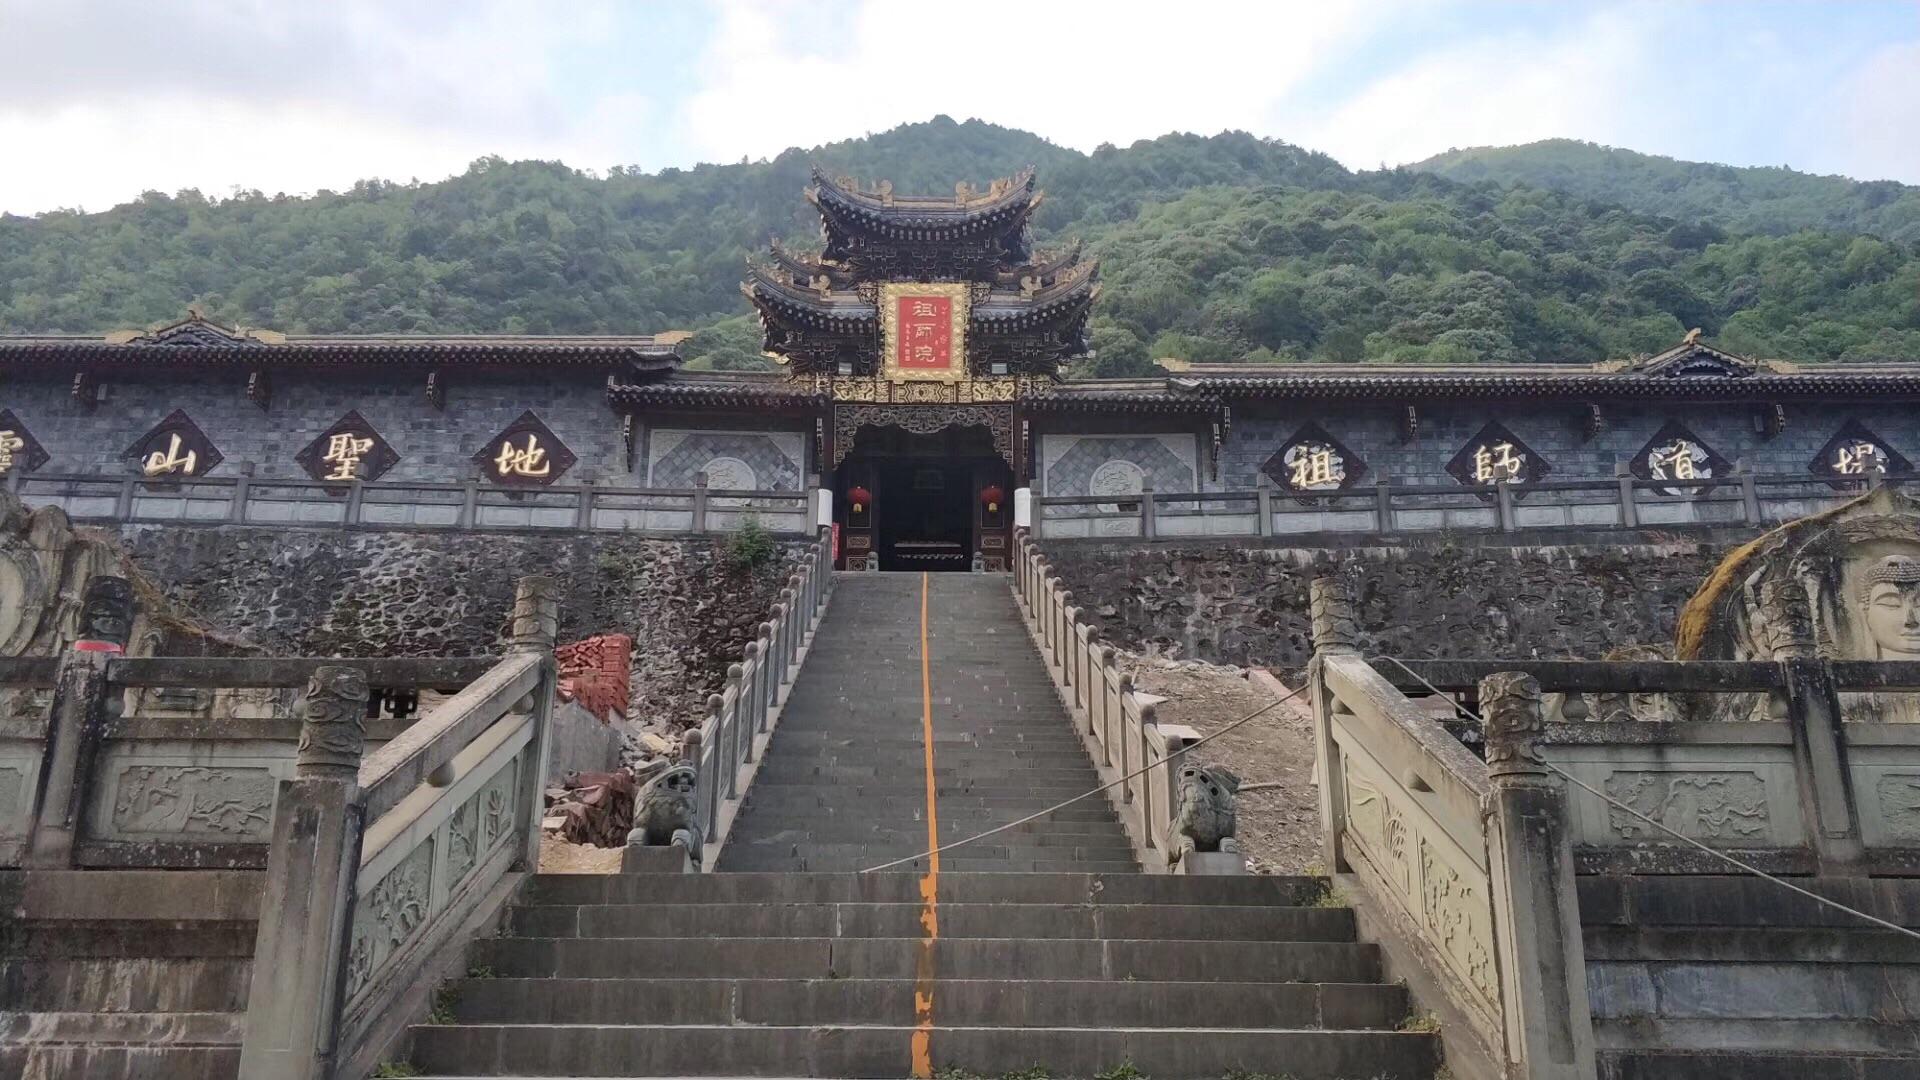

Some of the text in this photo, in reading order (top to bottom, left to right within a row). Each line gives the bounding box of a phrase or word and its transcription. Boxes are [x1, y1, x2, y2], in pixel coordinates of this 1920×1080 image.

[142, 432, 550, 481] 山 聖 地
[1287, 444, 1338, 487] 祖
[1473, 442, 1521, 483] 師
